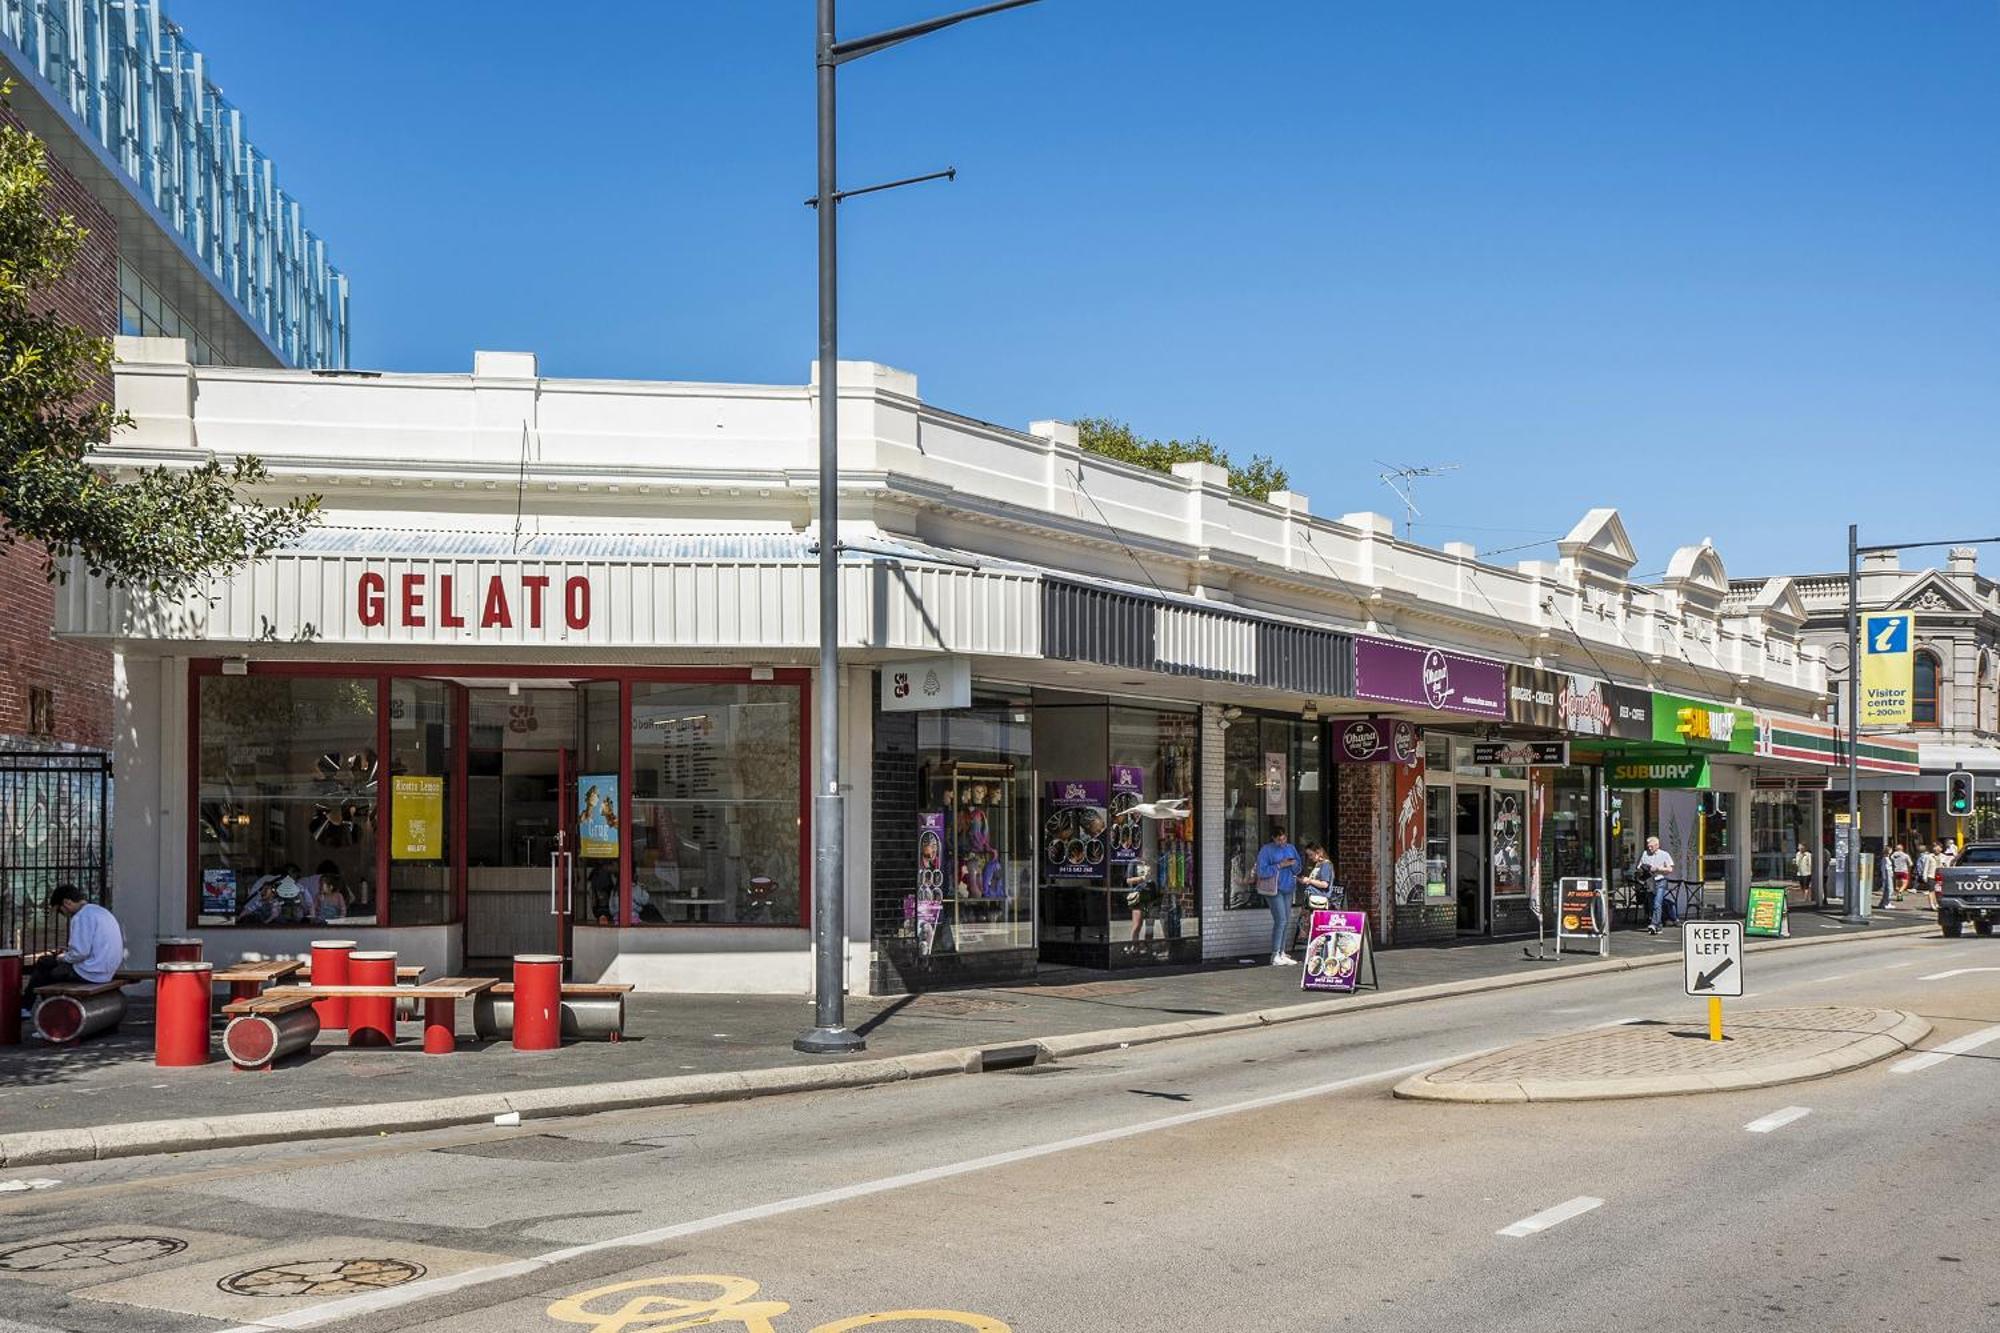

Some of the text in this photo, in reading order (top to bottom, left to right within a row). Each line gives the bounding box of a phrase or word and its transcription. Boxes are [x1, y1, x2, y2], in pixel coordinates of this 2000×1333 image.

[357, 571, 591, 630] GELATO
[1867, 689, 1907, 698] Visitor
[1867, 698, 1906, 707] centre
[1614, 764, 1694, 780] SUBWAY
[1694, 928, 1731, 940] KEEP
[1695, 943, 1730, 955] LEFT
